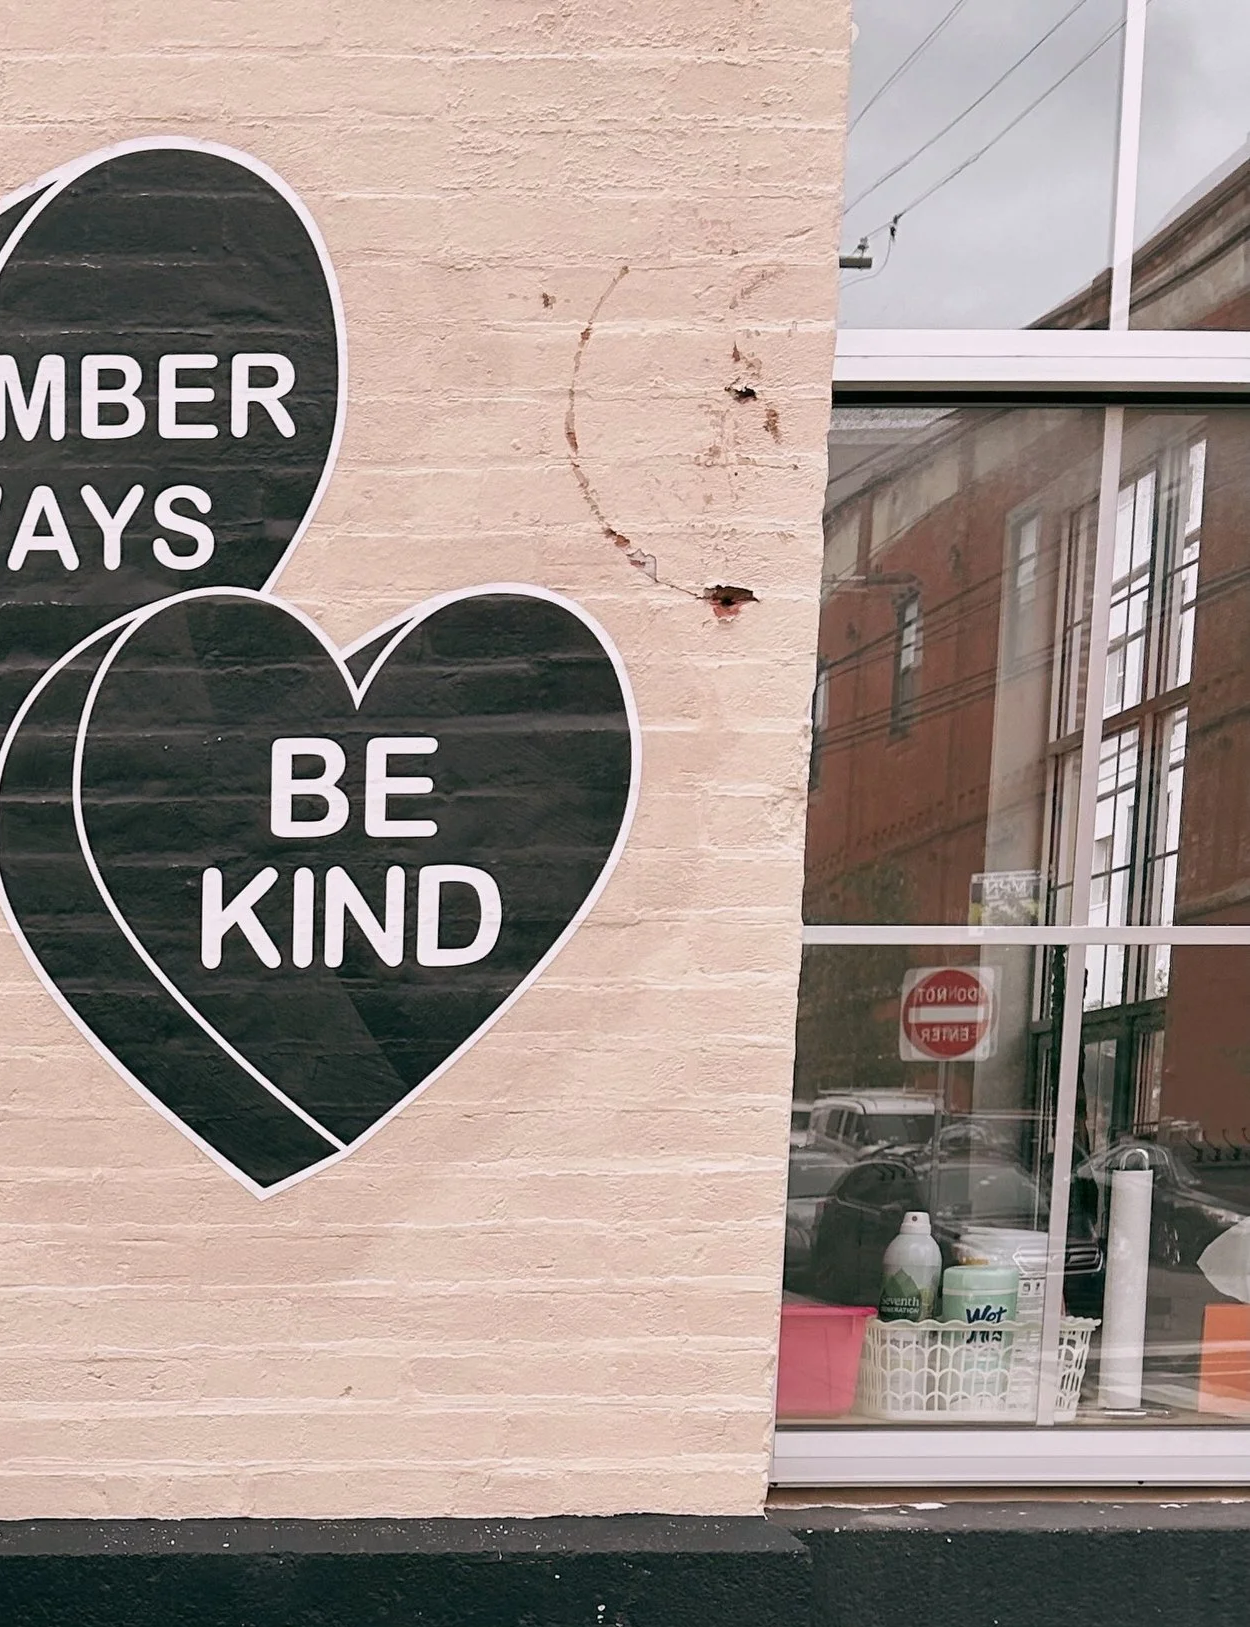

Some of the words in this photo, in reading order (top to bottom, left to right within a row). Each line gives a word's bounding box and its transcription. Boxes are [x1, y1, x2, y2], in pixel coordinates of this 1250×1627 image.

[269, 736, 440, 839] BE
[200, 863, 503, 971] KIND
[965, 1304, 1007, 1323] Wet
